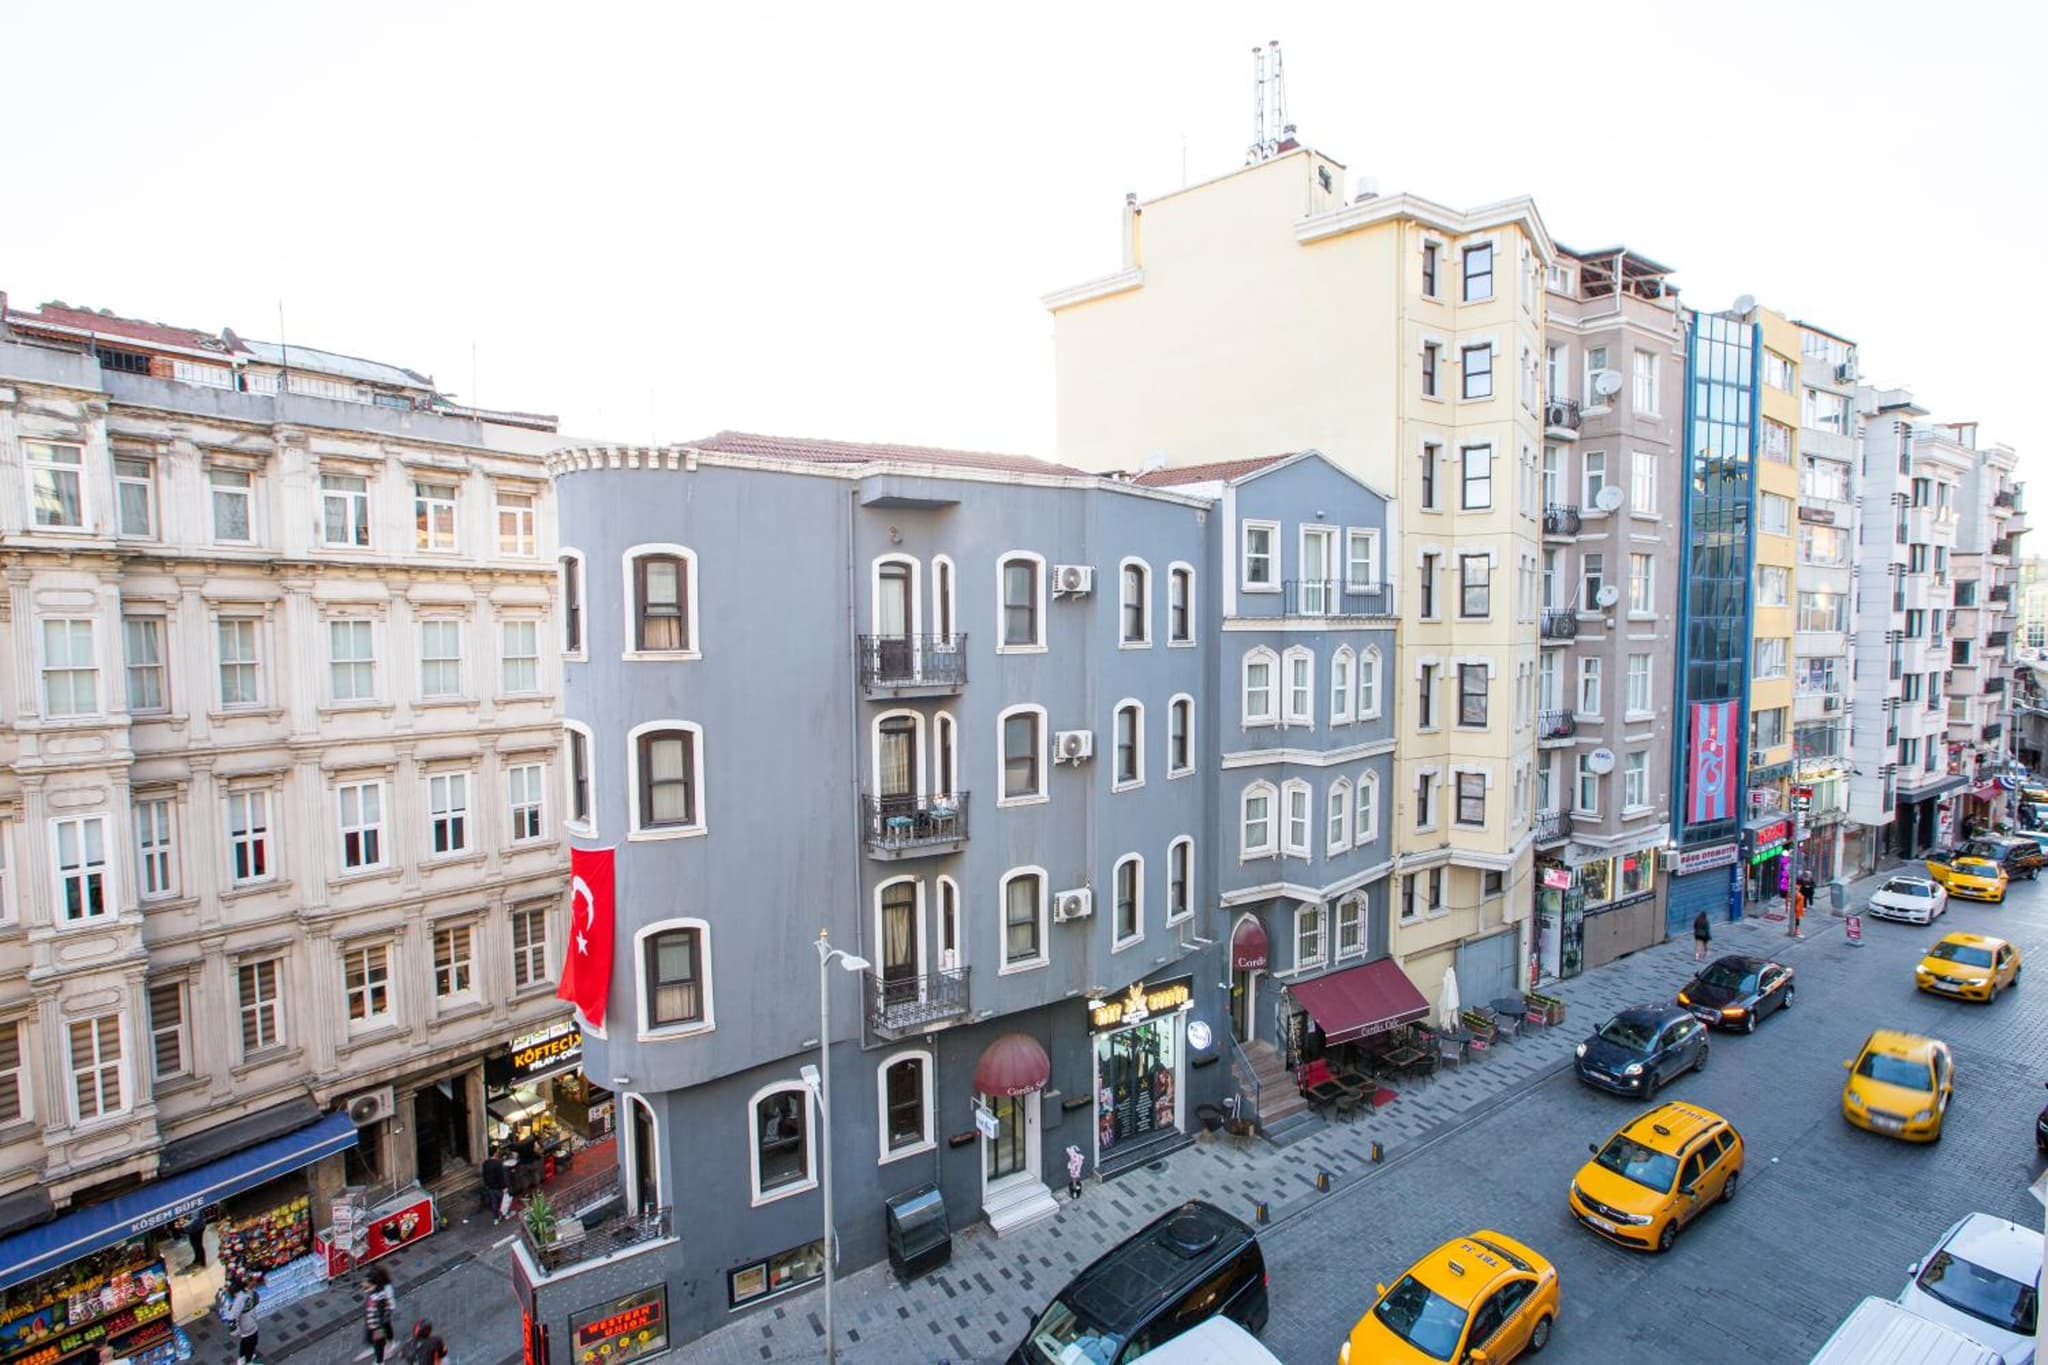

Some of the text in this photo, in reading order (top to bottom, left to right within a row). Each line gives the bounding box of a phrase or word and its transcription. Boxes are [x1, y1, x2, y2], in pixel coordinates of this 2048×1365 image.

[514, 1033, 573, 1068] KÖFTECİ
[174, 1196, 205, 1215] BÜFE
[587, 1304, 651, 1337] WESTERN UNION
